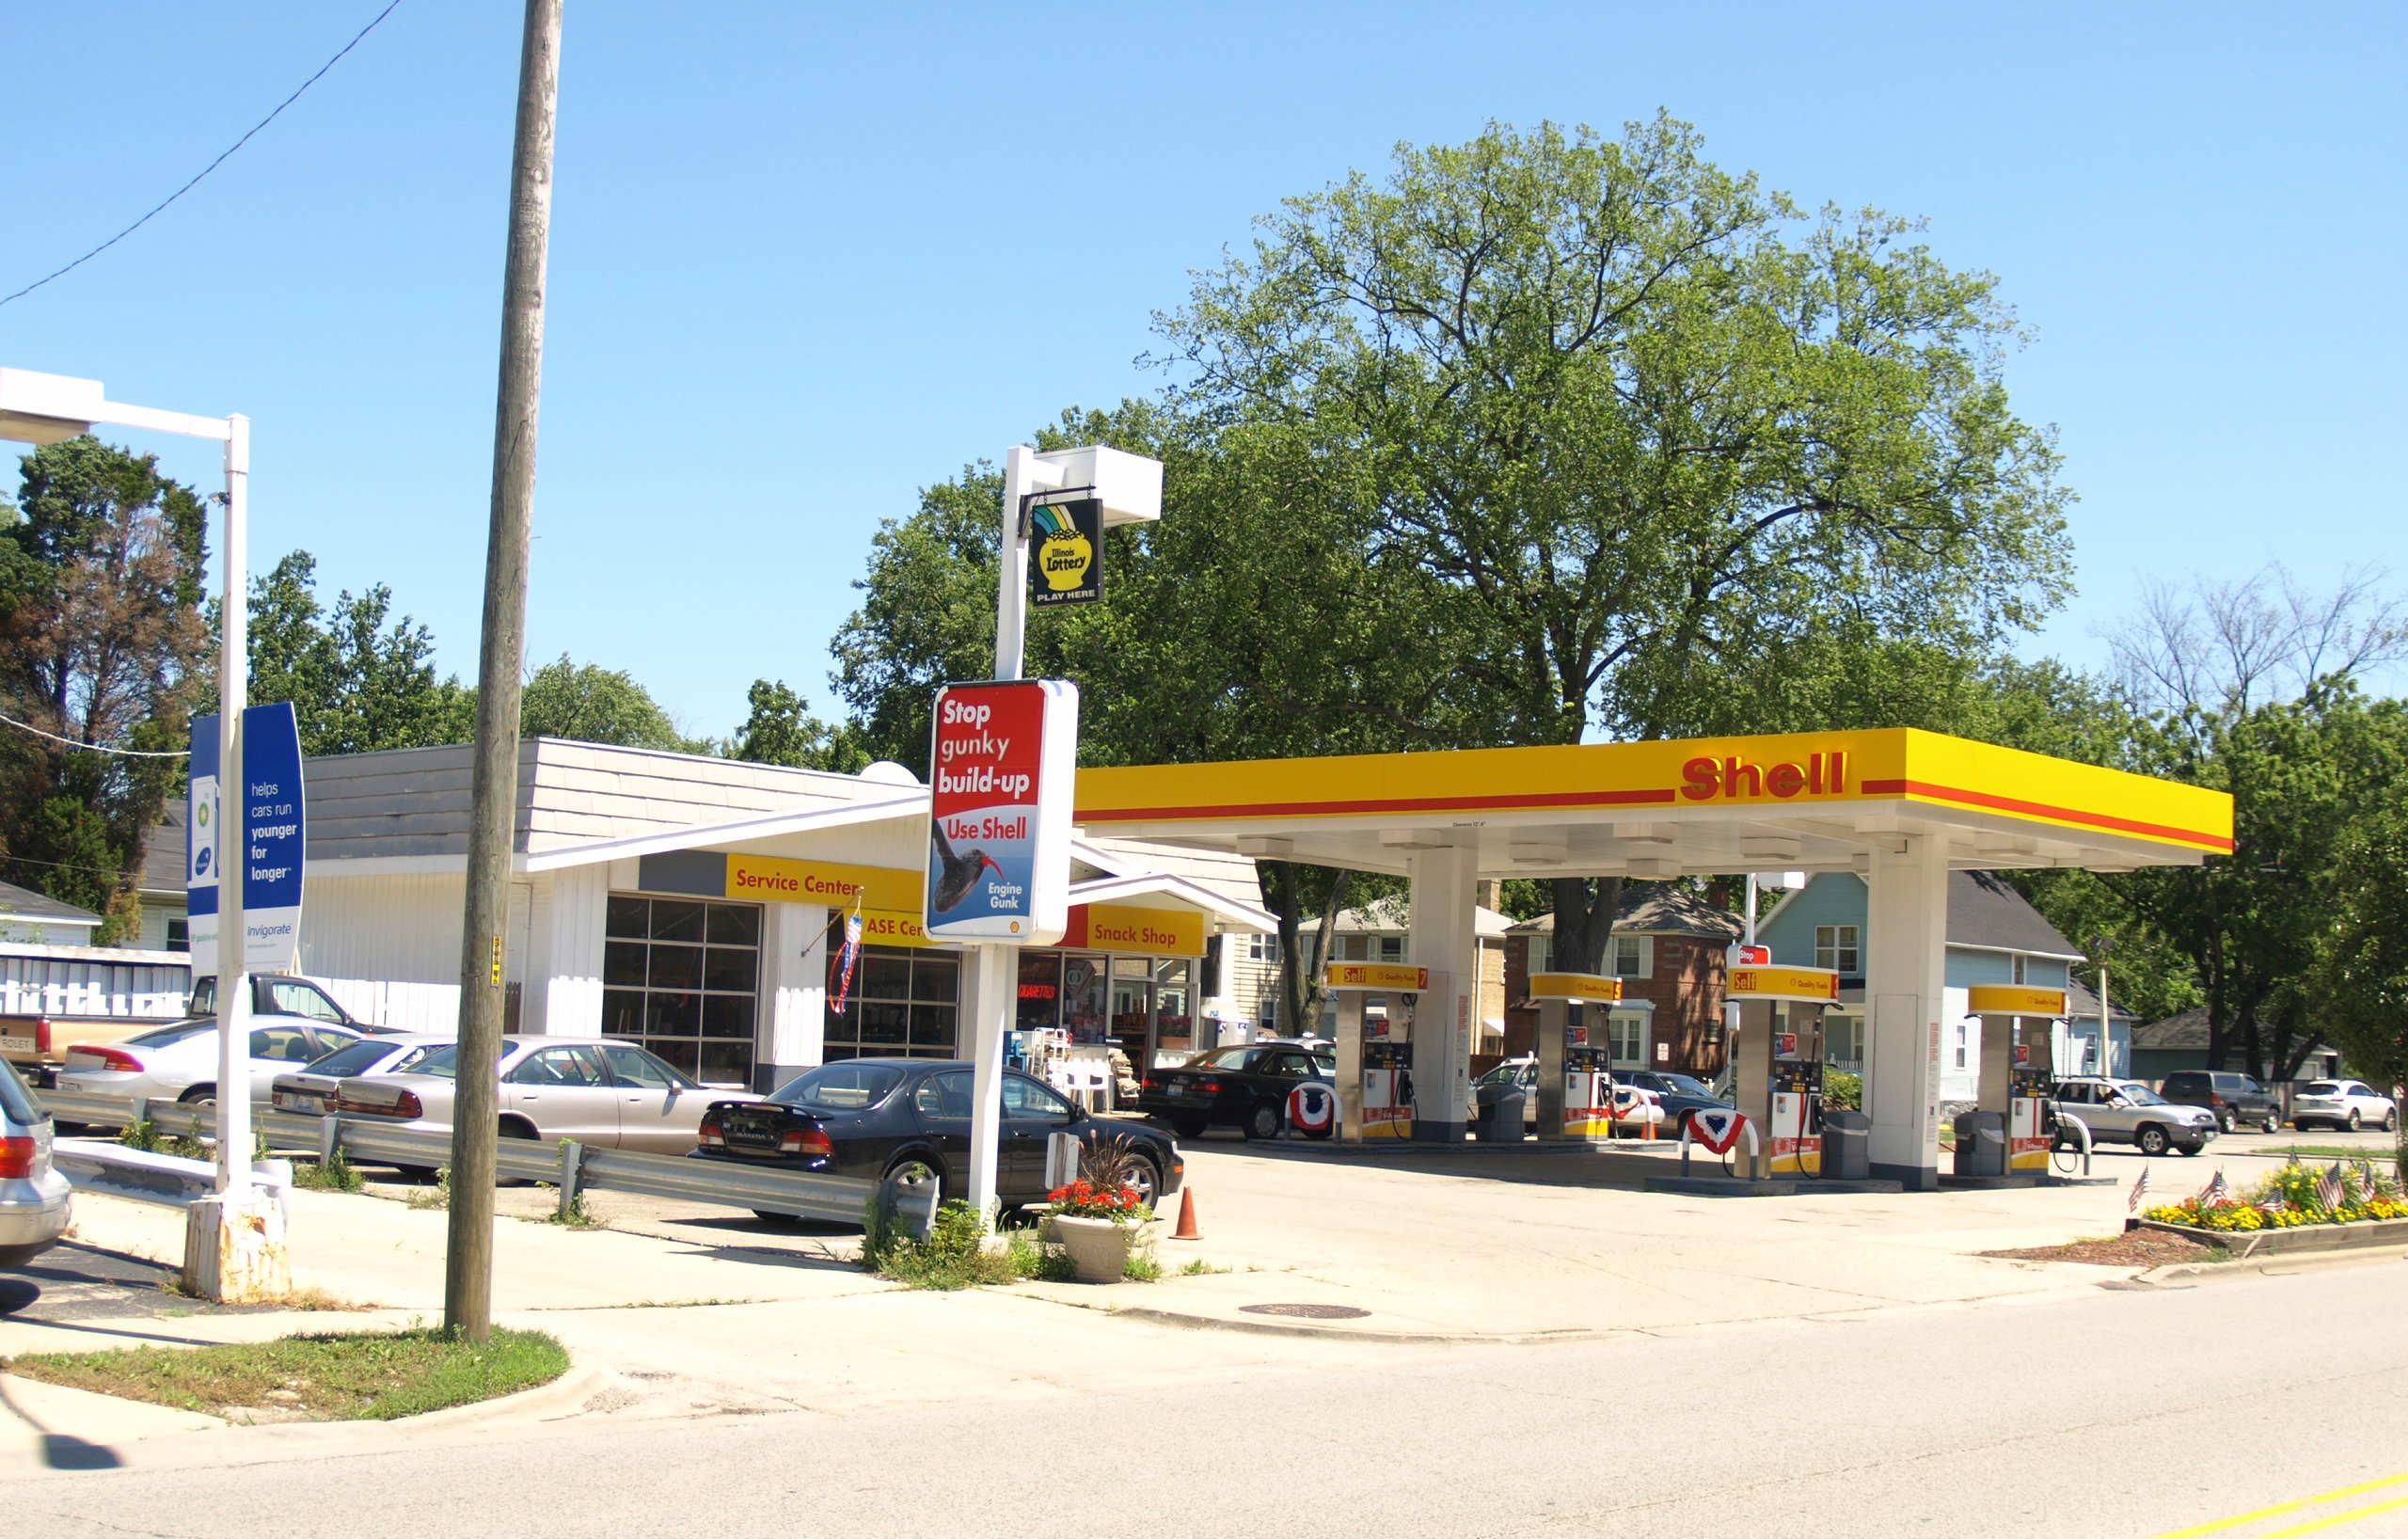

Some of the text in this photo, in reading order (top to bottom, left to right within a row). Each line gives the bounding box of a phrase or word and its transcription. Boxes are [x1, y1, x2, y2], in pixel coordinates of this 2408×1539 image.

[1052, 547, 1075, 558] Illinois
[1046, 556, 1086, 572] Lottery
[1037, 589, 1096, 602] PLAY HERE
[943, 699, 990, 730] Stop
[941, 730, 1011, 763] gunky
[938, 767, 1031, 800] build-up
[1679, 751, 1848, 801] Shell
[250, 782, 278, 798] helps
[251, 803, 293, 818] cars run
[251, 824, 297, 842] younger
[947, 816, 1028, 841] Use Shell
[251, 845, 267, 860] for
[736, 869, 860, 896] Service Center
[988, 881, 1023, 897] Engine
[990, 896, 1020, 910] Gunk
[246, 924, 293, 939] invigorate
[866, 917, 895, 935] ASE
[1094, 924, 1177, 948] Snack Shop
[1739, 950, 1754, 962] Stop
[1345, 968, 1368, 983] Self
[1734, 974, 1756, 991] Self
[1614, 983, 1622, 999] 5
